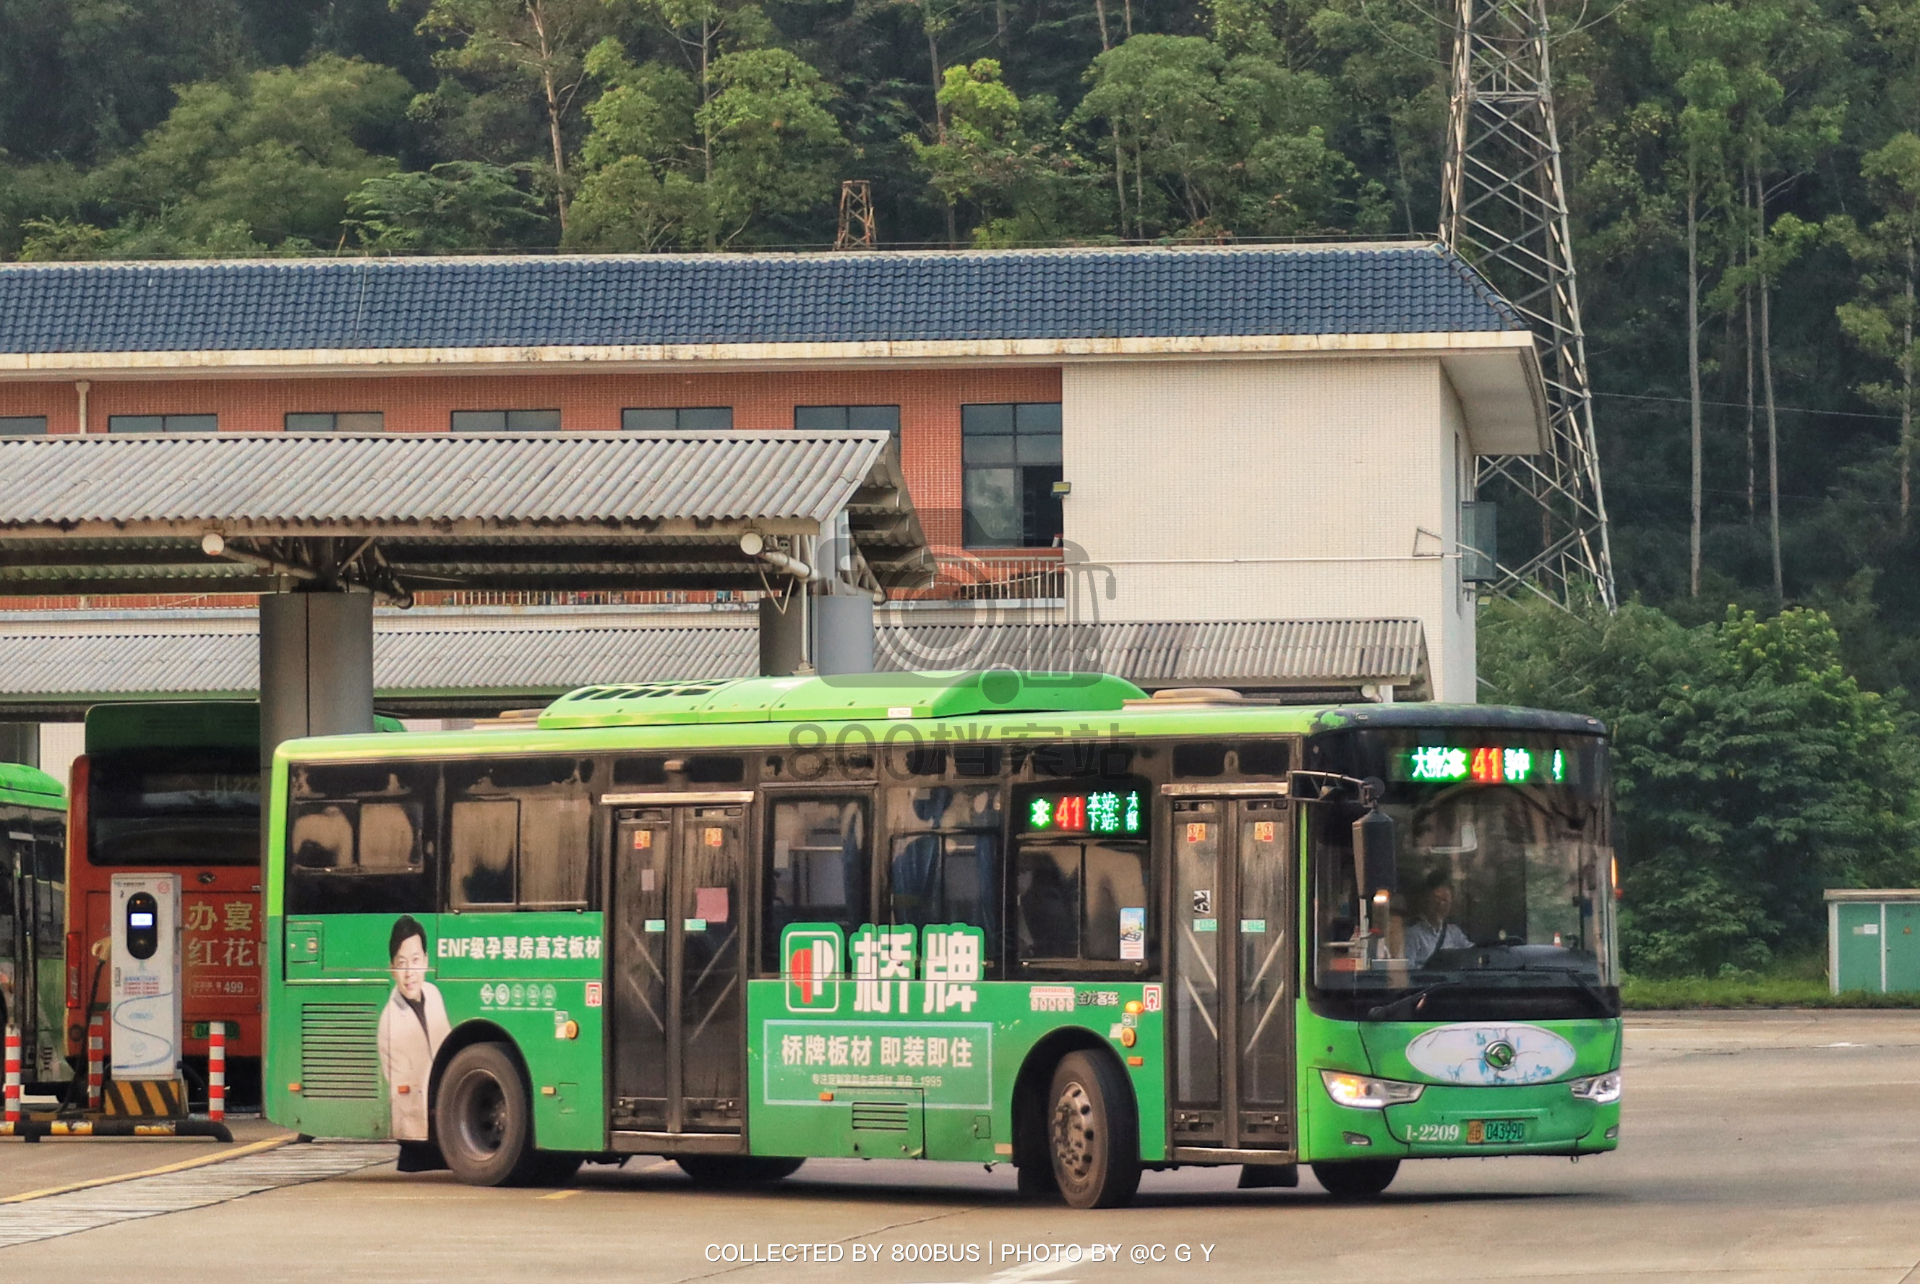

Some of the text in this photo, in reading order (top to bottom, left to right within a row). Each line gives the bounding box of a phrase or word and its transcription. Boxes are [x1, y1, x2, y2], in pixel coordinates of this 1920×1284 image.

[1472, 747, 1498, 779] 41
[1056, 796, 1081, 828] 41
[188, 901, 262, 931] 办宴
[188, 937, 262, 967] 红花
[437, 936, 602, 959] ENF级孕婴房高定板材
[224, 981, 243, 993] 499
[853, 931, 979, 1013] 桥牌
[1077, 991, 1119, 1006] 金龙客车
[781, 1034, 973, 1068] 桥牌板材 即装即住
[1406, 1124, 1459, 1141] 1-2209
